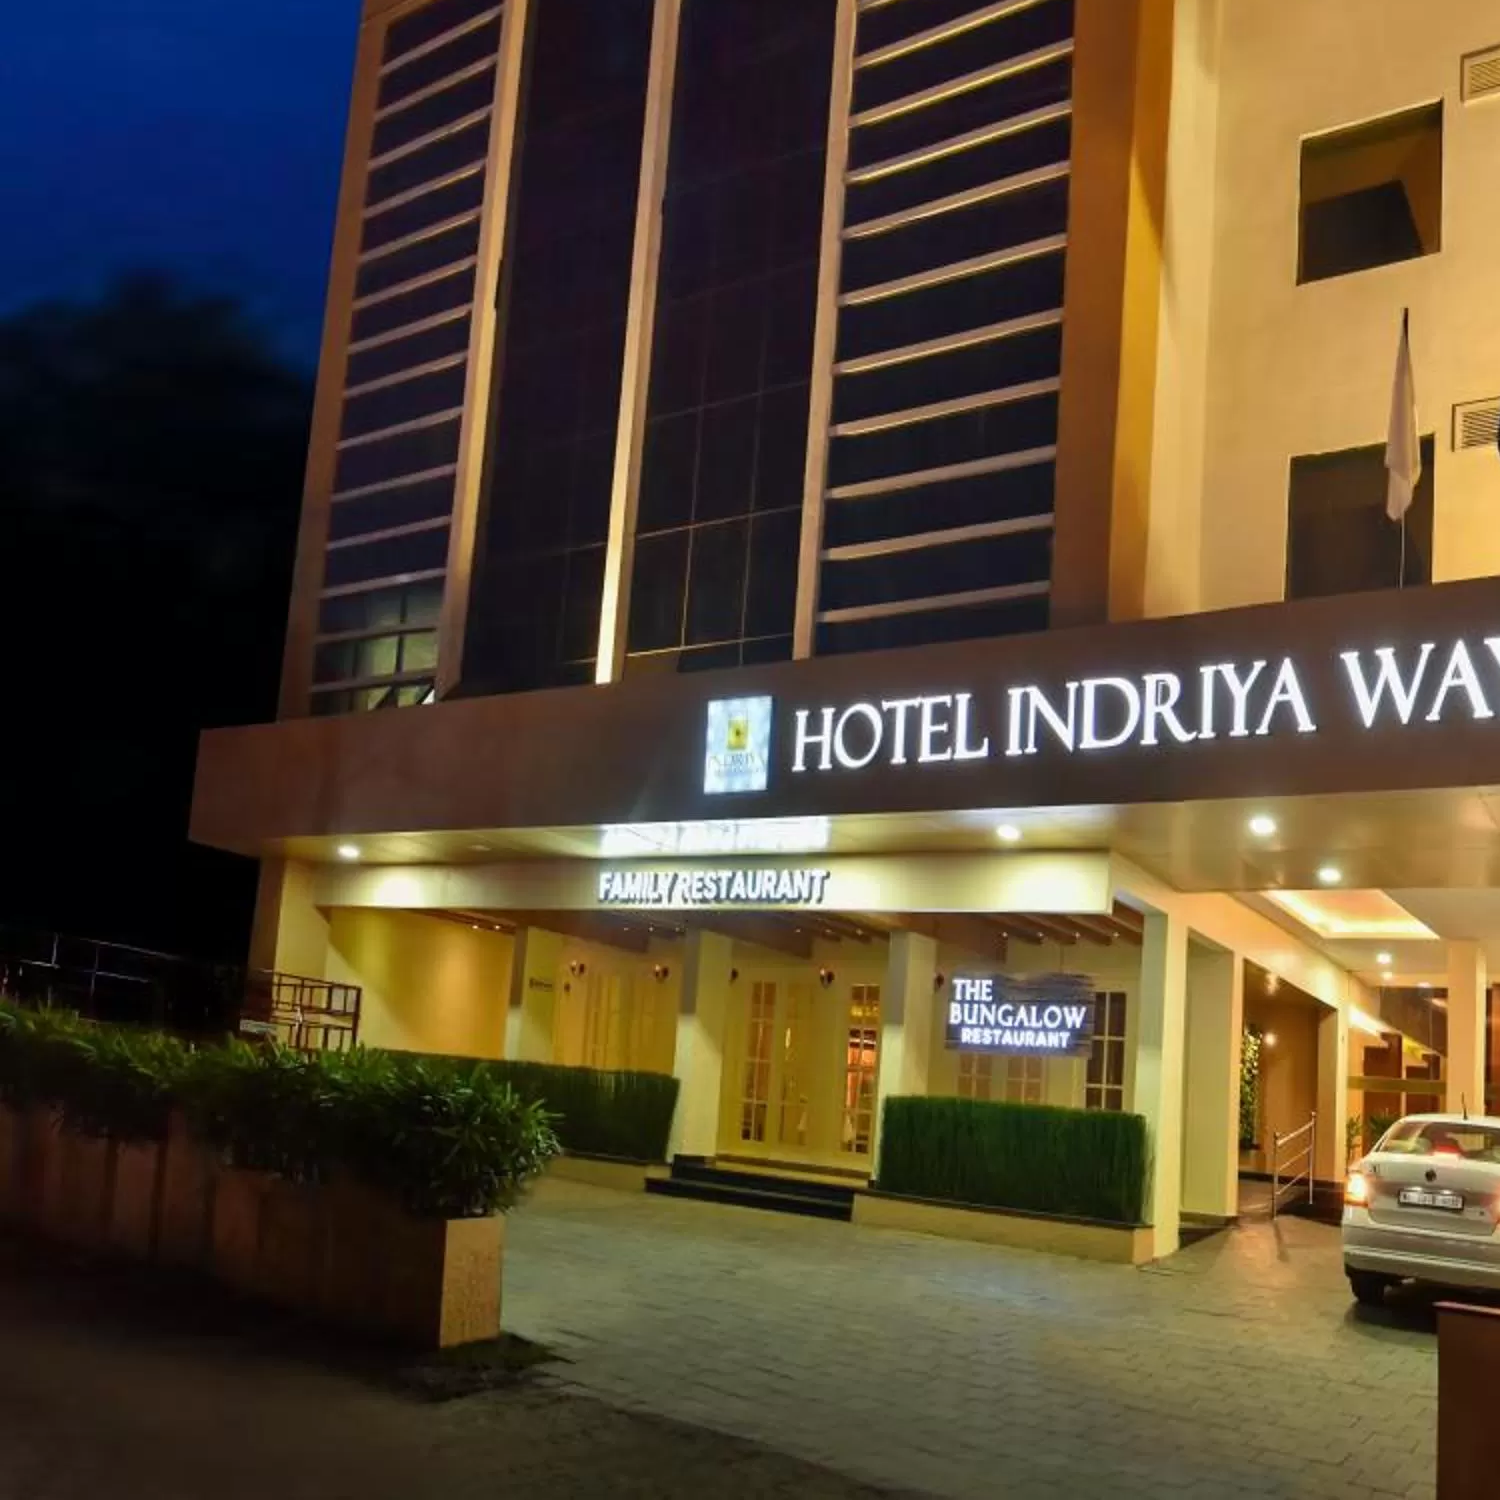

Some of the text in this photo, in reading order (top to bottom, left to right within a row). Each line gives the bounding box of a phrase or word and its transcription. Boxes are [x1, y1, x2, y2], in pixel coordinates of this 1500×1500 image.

[792, 693, 990, 773] HOTEL
[1004, 656, 1318, 757] INDRIYA
[599, 869, 831, 903] FAMILY RESTAURANT
[952, 978, 993, 1001] THE
[949, 1002, 1087, 1029] BUNGALOW
[960, 1027, 1071, 1048] RESTAURANT
